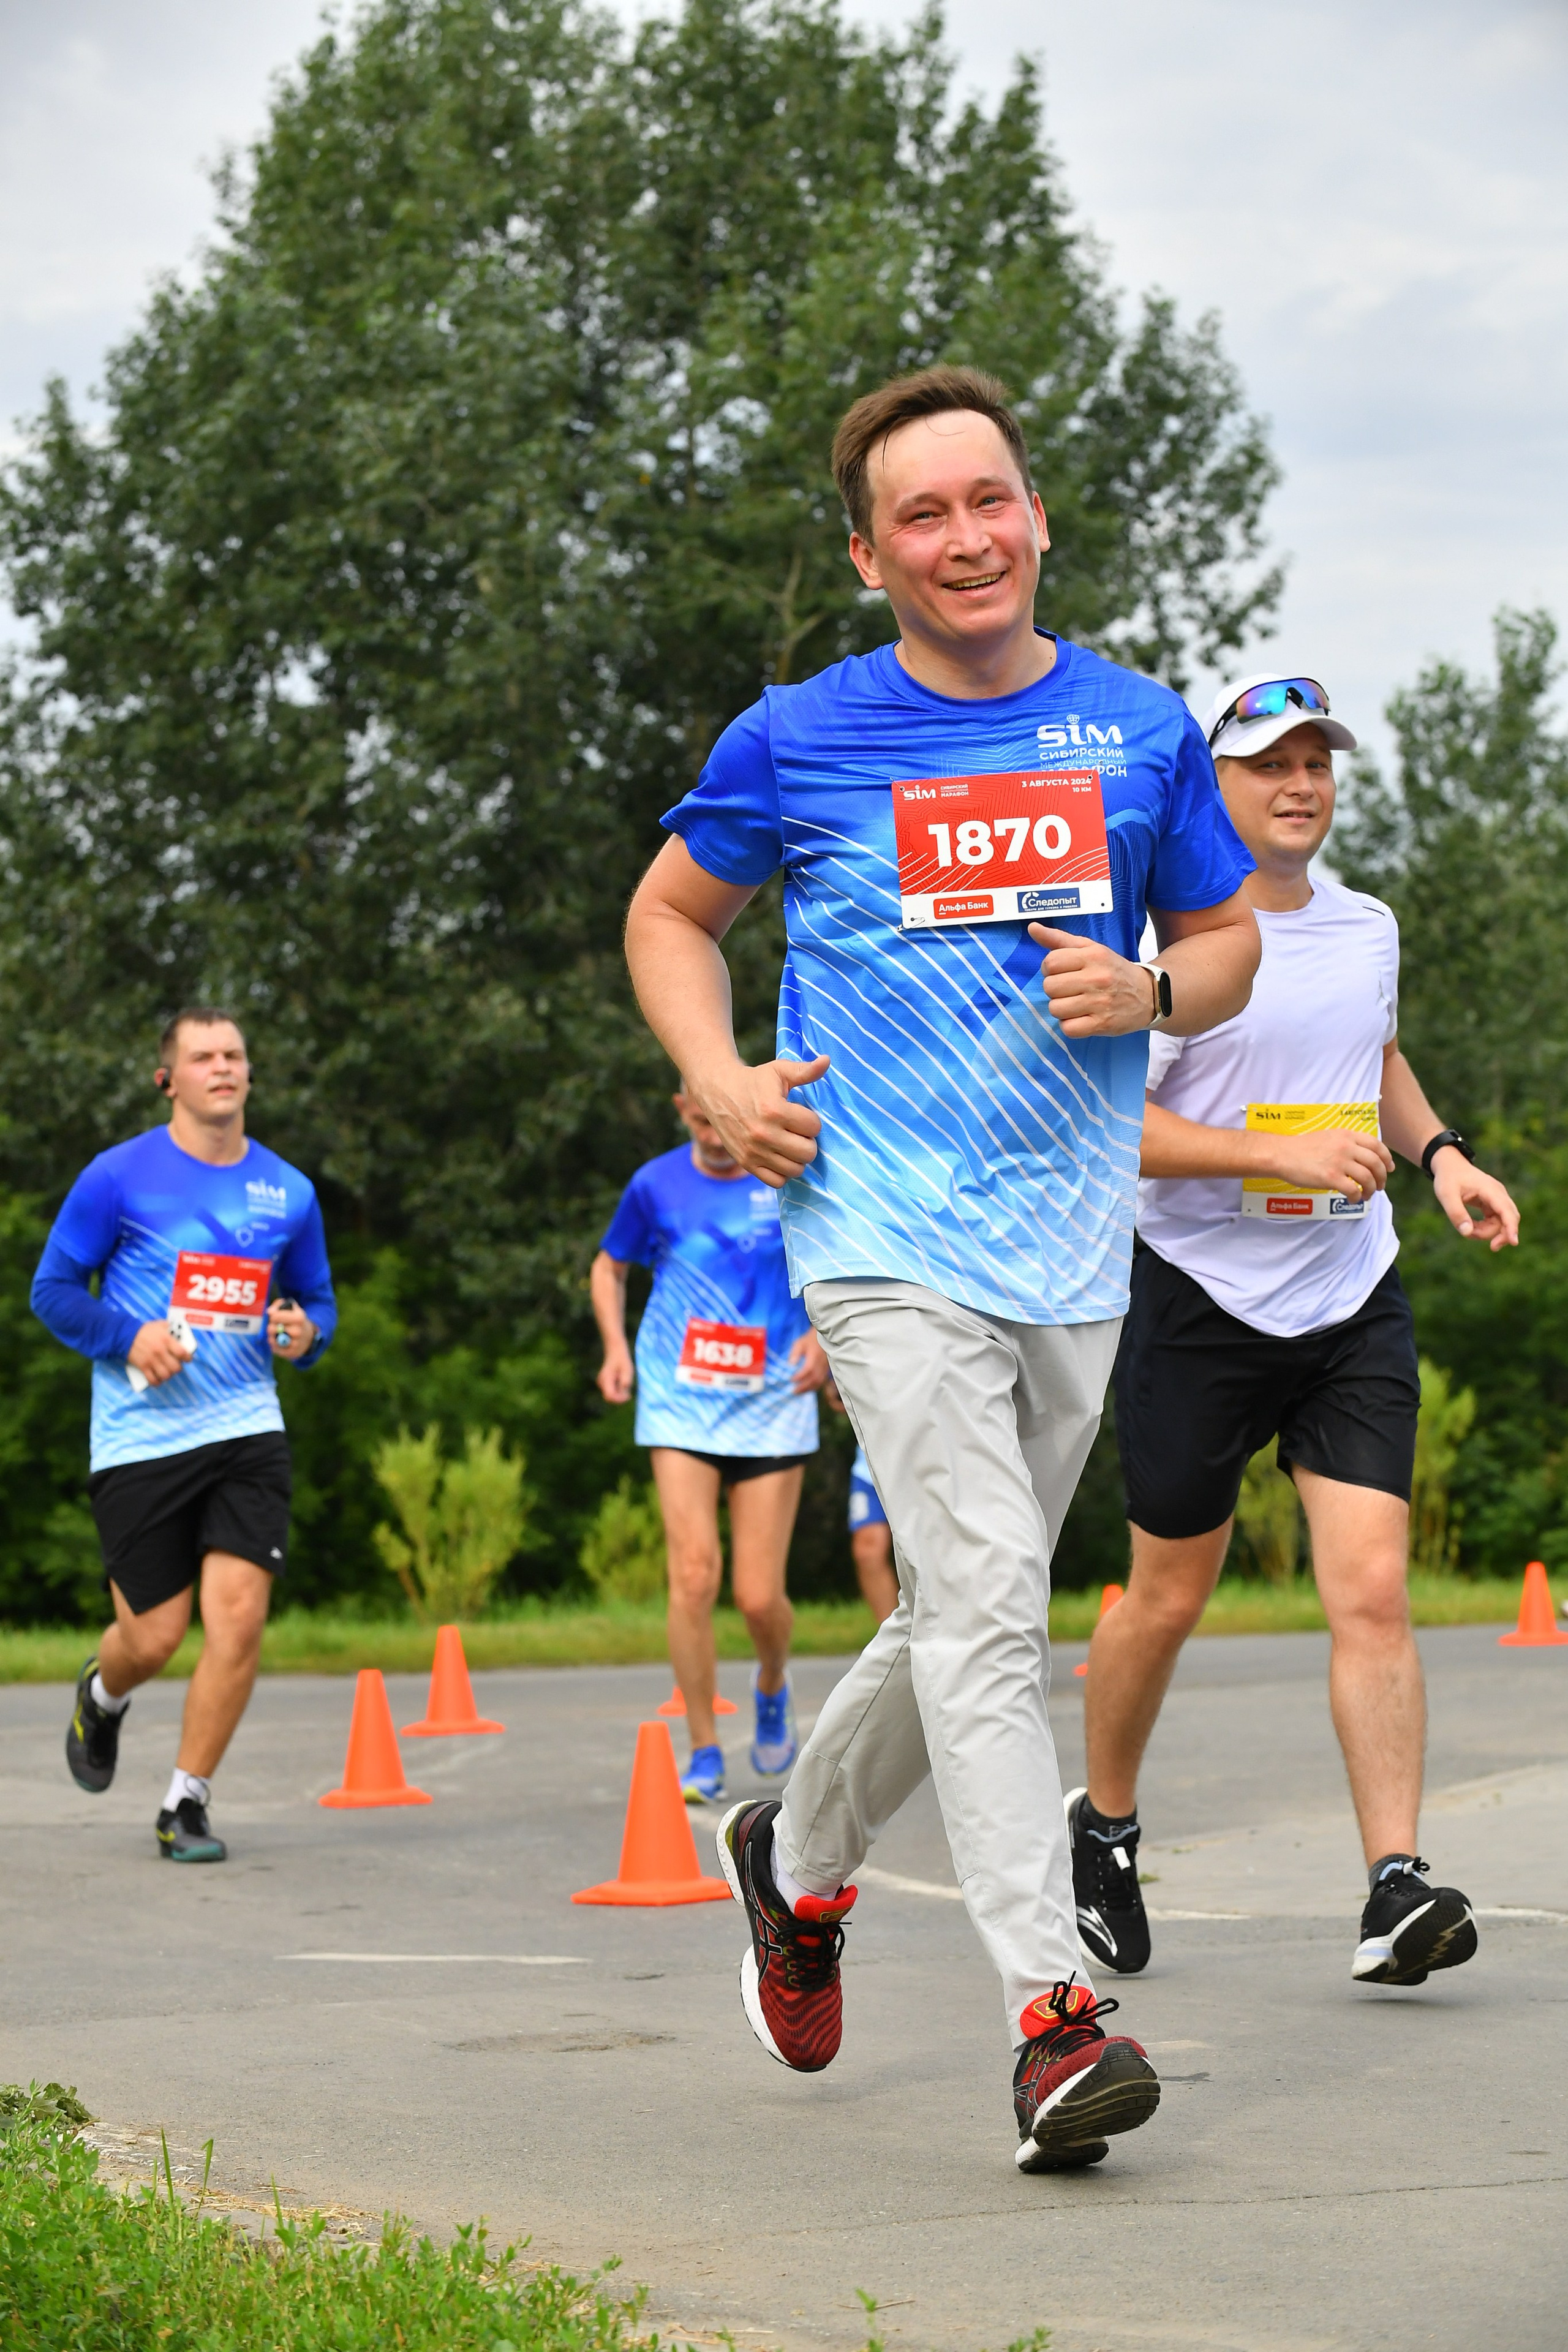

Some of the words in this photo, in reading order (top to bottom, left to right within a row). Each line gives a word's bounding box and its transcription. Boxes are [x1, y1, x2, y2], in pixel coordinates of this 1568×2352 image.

[1039, 747, 1125, 760] СИБИРСКИЙ
[1040, 758, 1127, 769] МЕЖДУНАРОДНЫЙ
[1029, 778, 1069, 787] АВГУСТА
[927, 814, 1072, 867] 1870
[938, 902, 967, 915] Альфа
[967, 901, 989, 910] Банк
[1028, 897, 1077, 907] Следопыт
[186, 1273, 258, 1306] 2955
